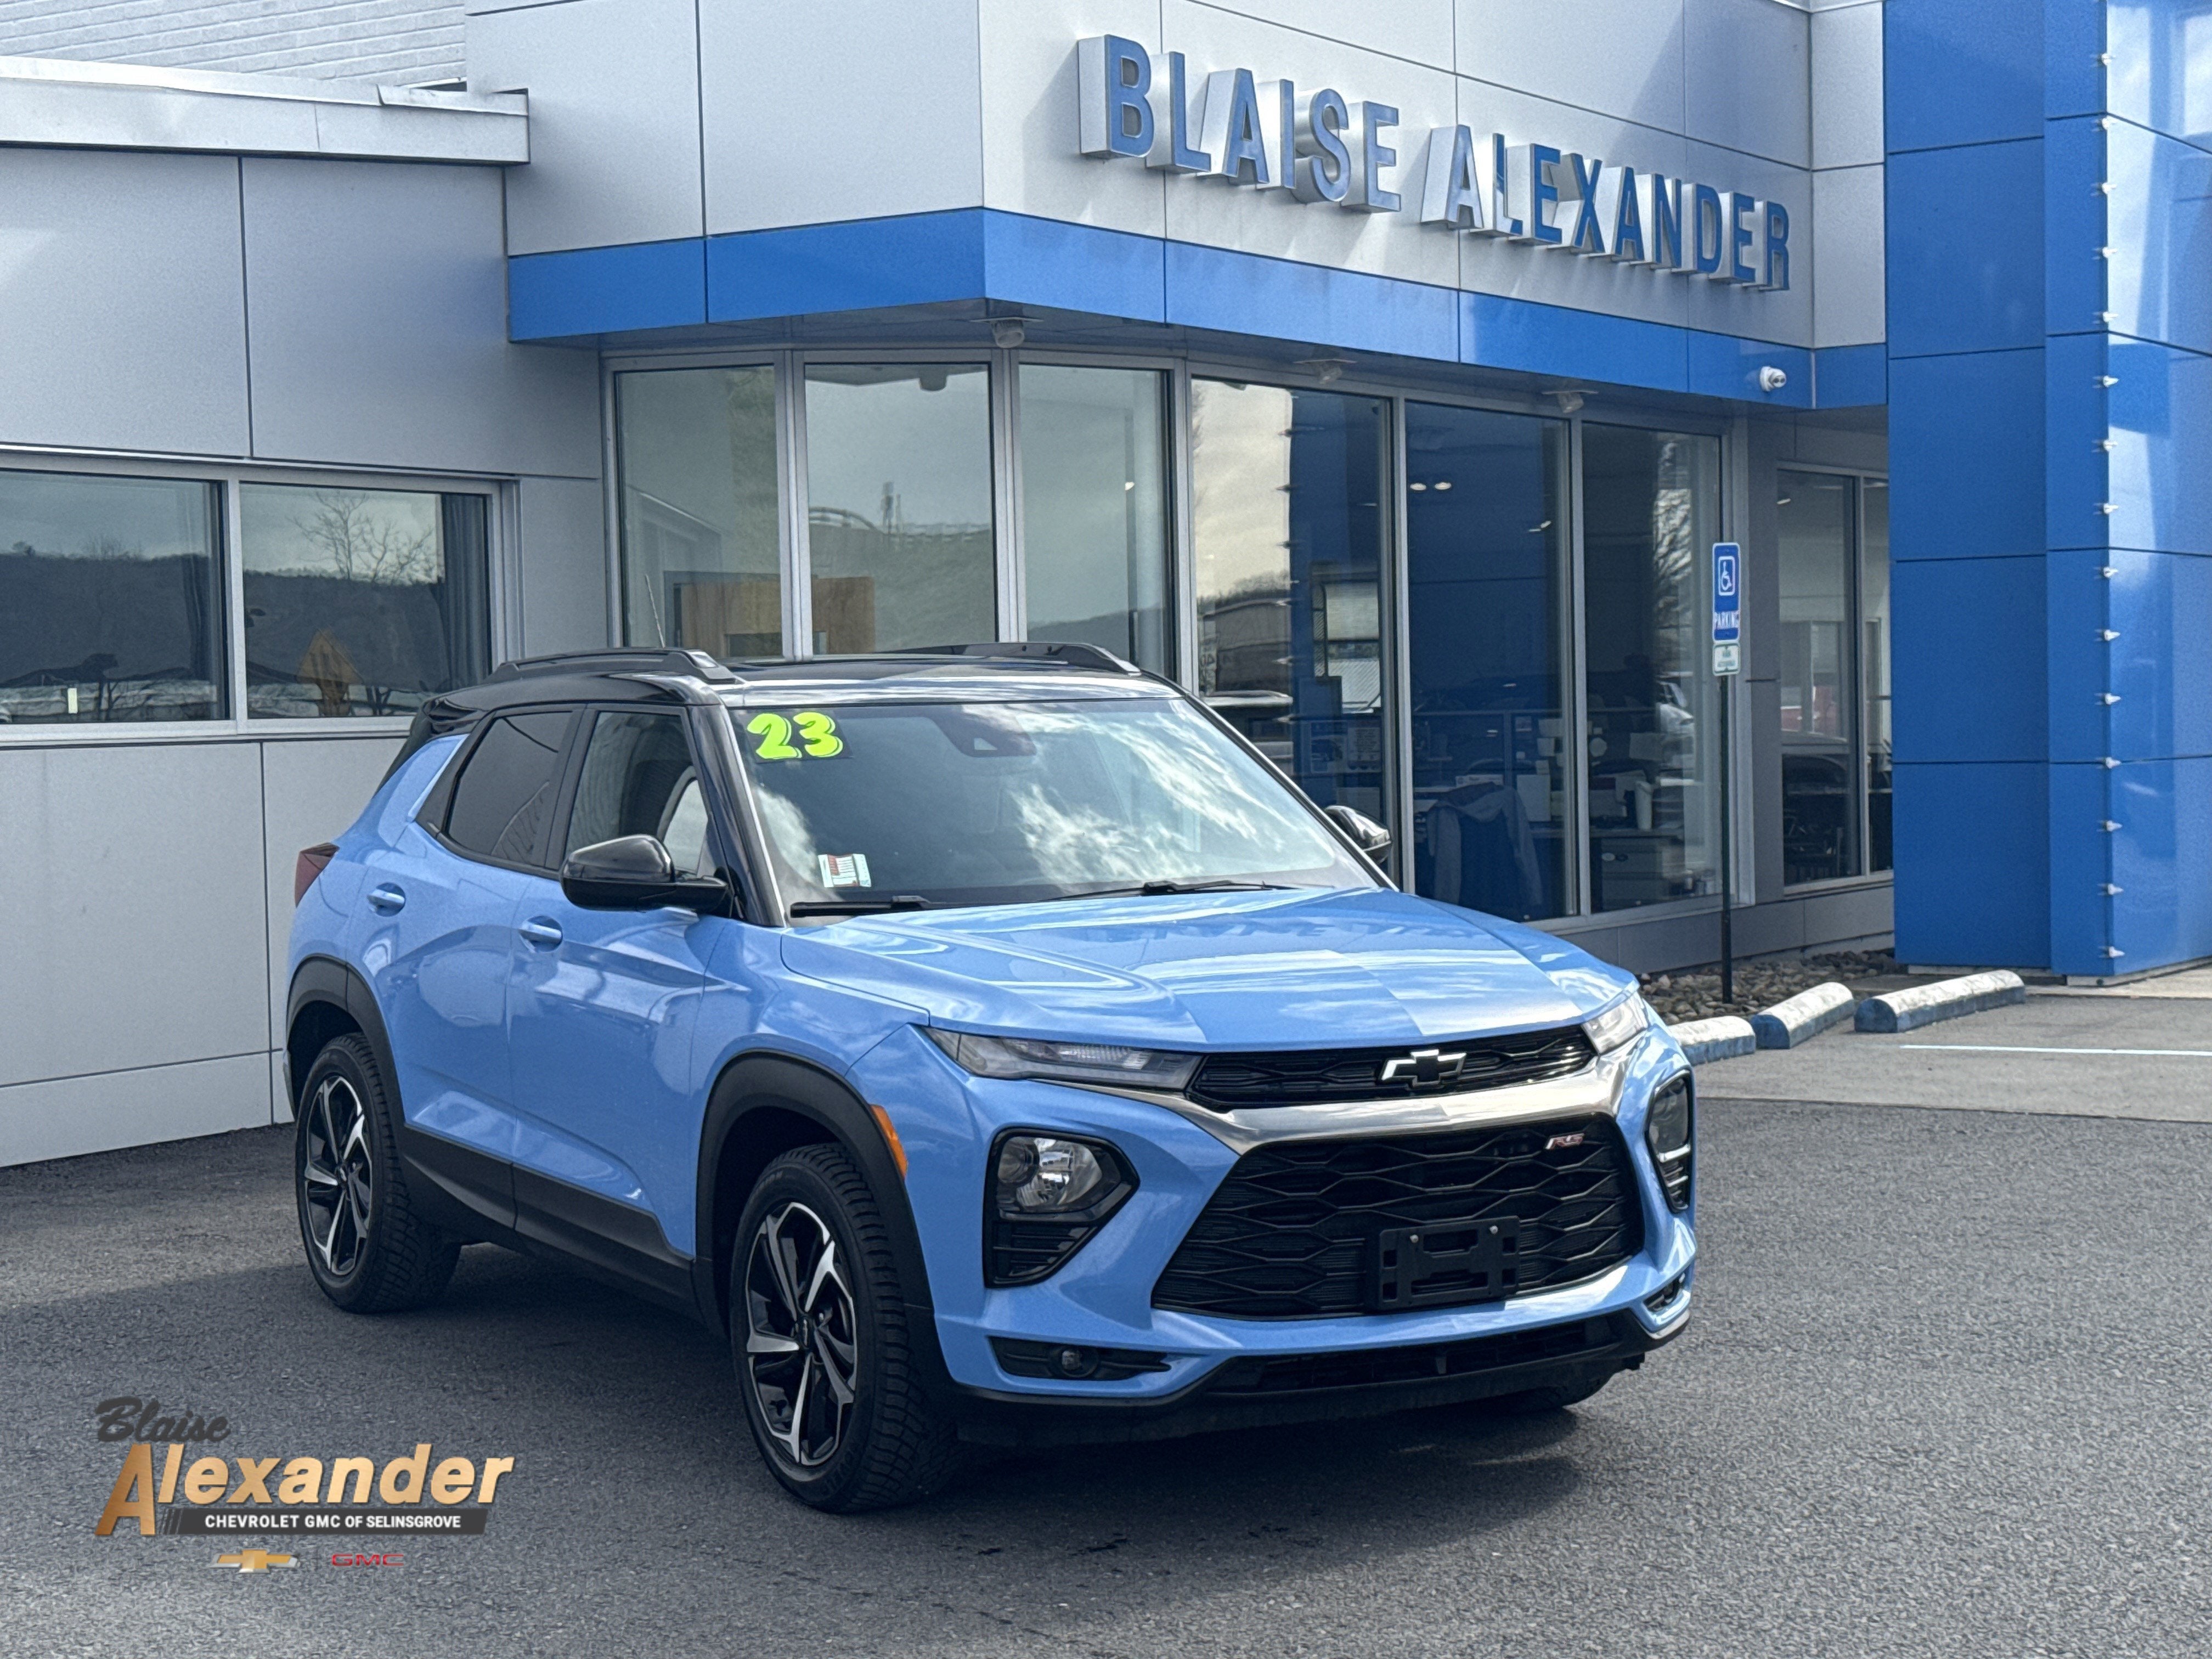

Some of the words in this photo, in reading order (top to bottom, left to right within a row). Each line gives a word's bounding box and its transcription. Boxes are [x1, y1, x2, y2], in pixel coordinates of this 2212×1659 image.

[1105, 34, 1401, 213] BLAISE
[1443, 124, 1791, 291] ALEXANDER
[747, 712, 843, 759] 23
[1545, 1133, 1584, 1150] RS
